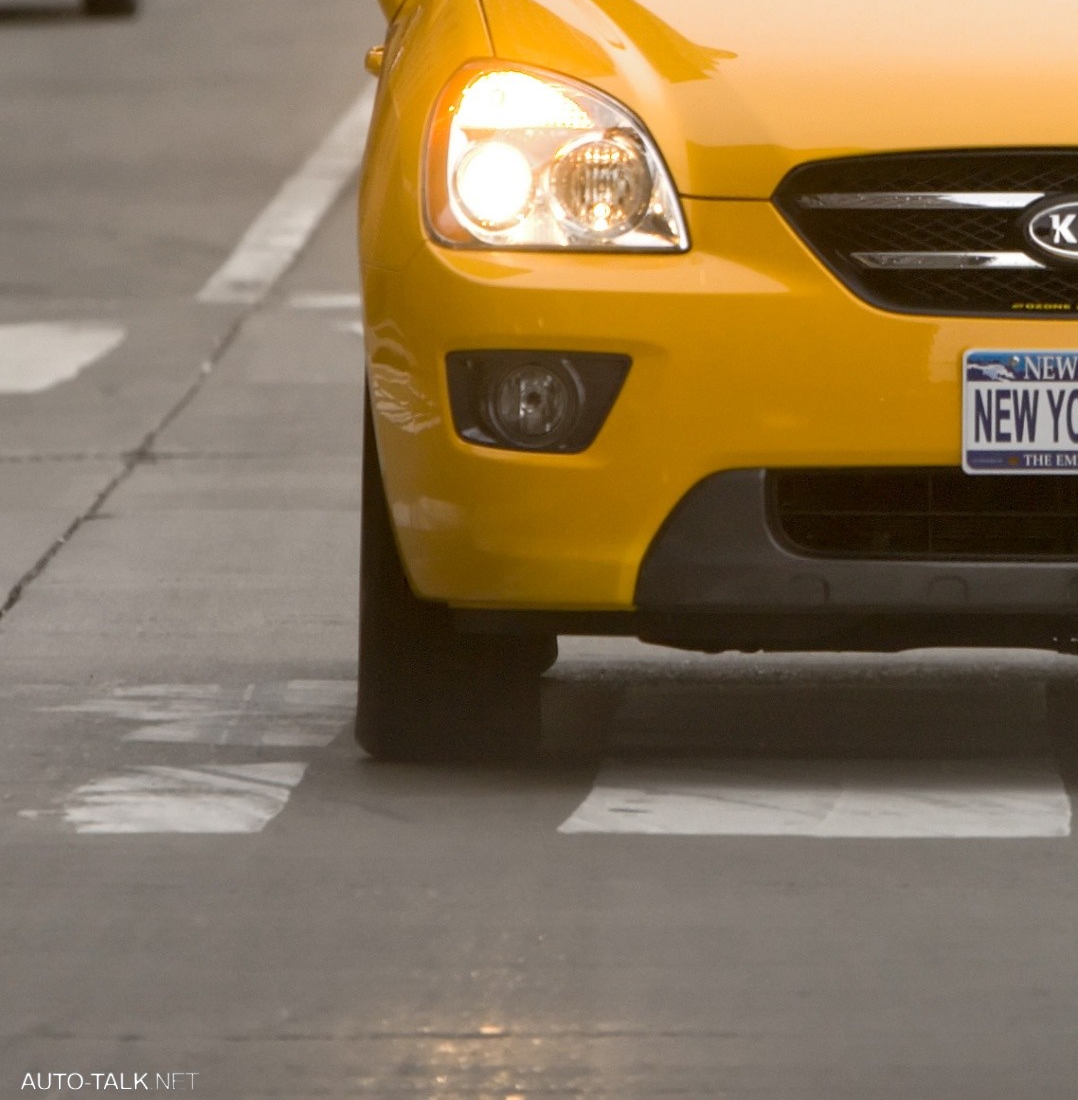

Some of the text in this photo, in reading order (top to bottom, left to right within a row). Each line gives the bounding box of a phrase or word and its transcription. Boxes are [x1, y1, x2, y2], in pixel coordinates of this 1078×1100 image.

[1024, 356, 1078, 380] NEW
[974, 388, 1039, 443] NEW
[1023, 454, 1052, 467] THE
